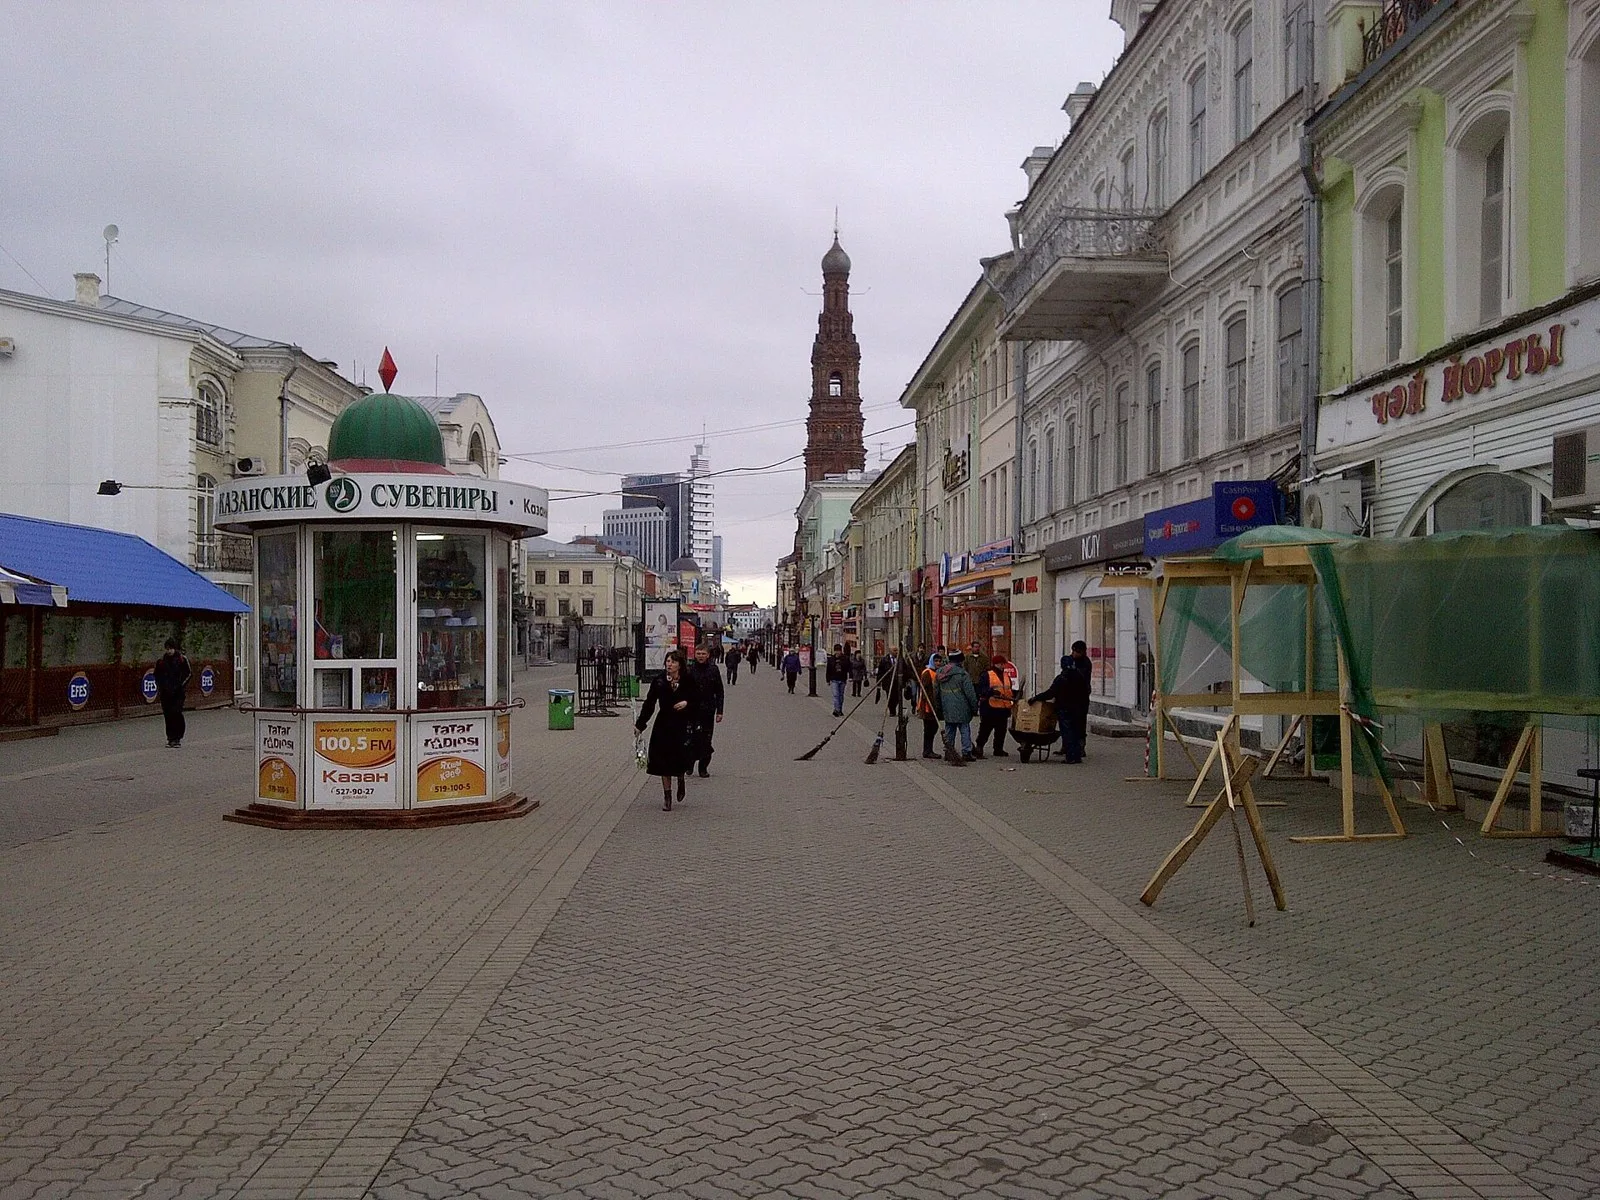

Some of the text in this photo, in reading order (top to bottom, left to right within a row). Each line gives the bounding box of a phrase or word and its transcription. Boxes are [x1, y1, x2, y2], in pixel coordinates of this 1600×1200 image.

[218, 484, 498, 515] КАЗАНСКИЕ СУВЕНИРЫ
[144, 680, 157, 692] EFES
[202, 675, 213, 687] EFES
[70, 684, 87, 698] EFES
[319, 736, 392, 753] 100,5 FM
[322, 769, 389, 783] Казан
[434, 783, 471, 793] 519-100-5
